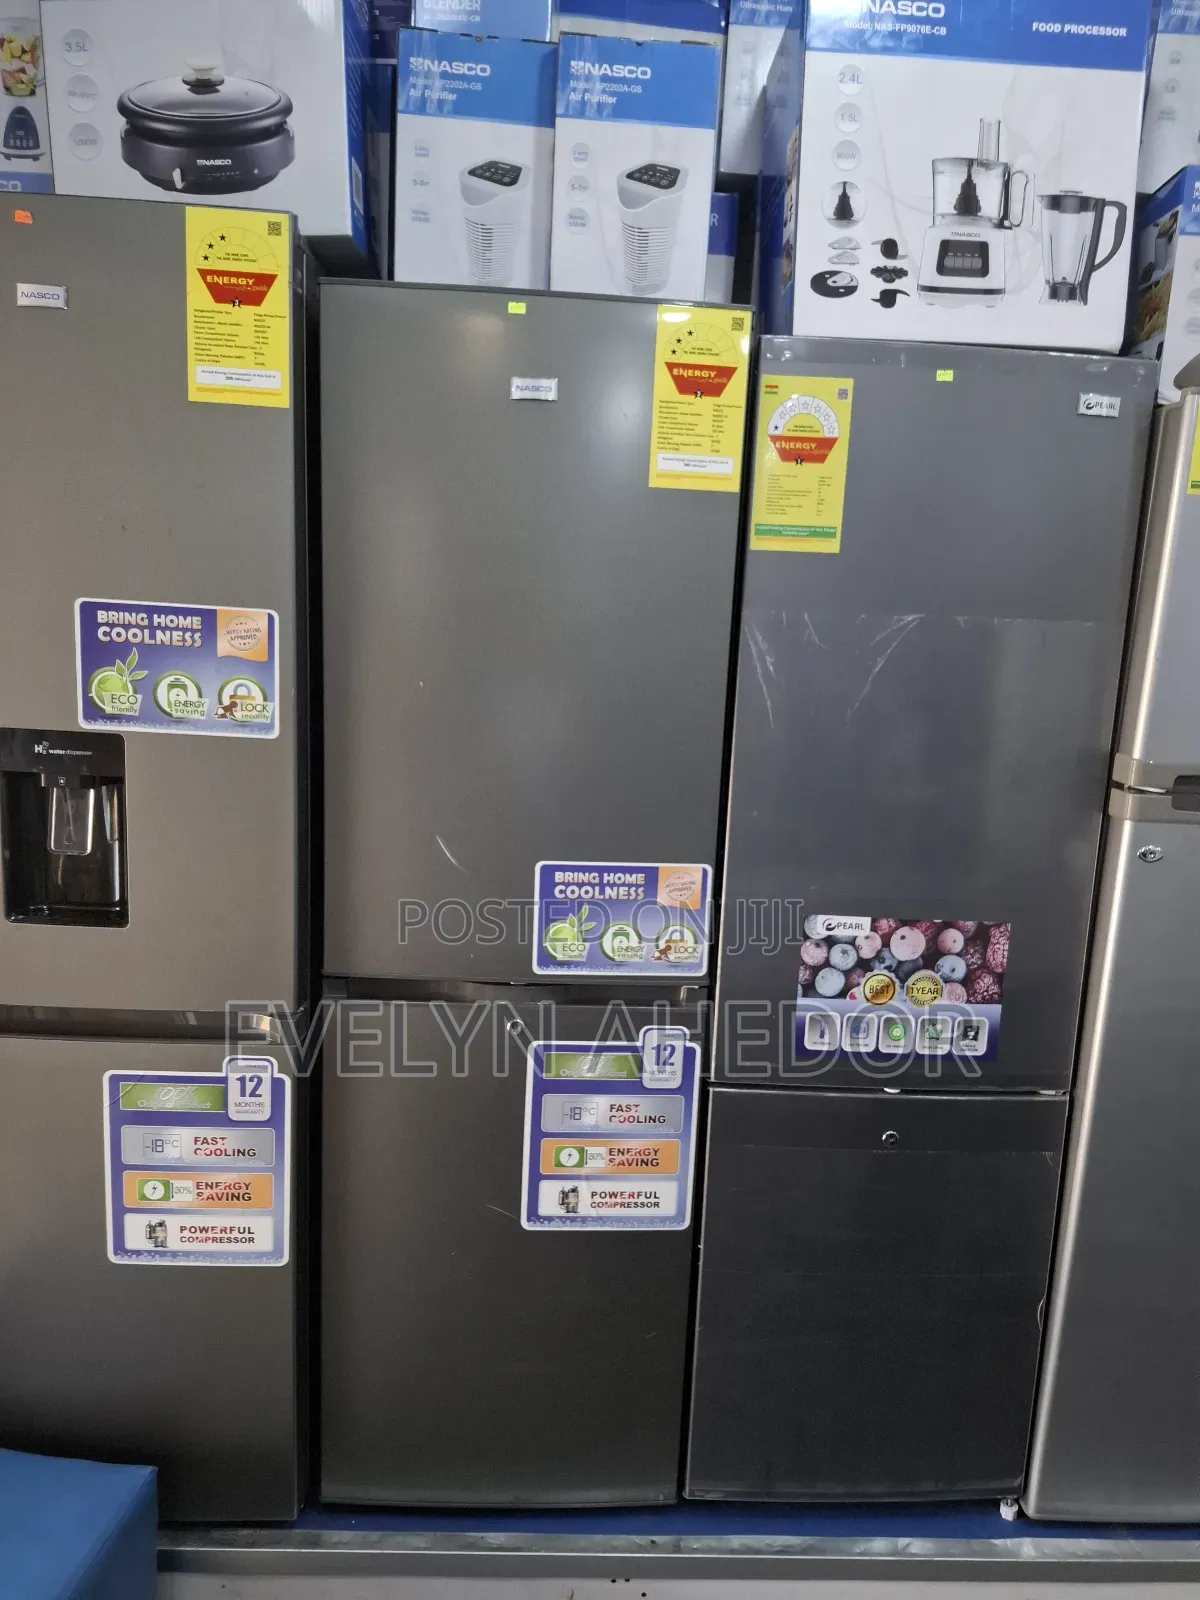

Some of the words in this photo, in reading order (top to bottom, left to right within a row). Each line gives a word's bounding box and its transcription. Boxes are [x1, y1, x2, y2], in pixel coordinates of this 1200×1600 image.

[862, 0, 946, 18] NASCO
[1031, 21, 1062, 33] FOOD
[1064, 23, 1127, 37] PROCESSOR
[423, 59, 491, 77] NASCO
[584, 61, 652, 79] NASCO
[839, 72, 863, 85] 2.4L
[409, 88, 423, 98] Air
[424, 90, 457, 101] Purifier
[569, 92, 583, 101] Air
[584, 92, 618, 104] Purifier
[206, 274, 255, 286] ENERGY
[21, 291, 60, 301] NASCO
[672, 367, 718, 379] ENERGY
[515, 385, 553, 393] NASCO
[775, 440, 818, 450] ENERGY
[97, 610, 149, 626] BRING
[153, 613, 202, 630] HOME
[97, 625, 203, 649] COOLNESS
[110, 693, 139, 705] ECO
[174, 699, 207, 709] ENERGY
[110, 704, 138, 715] friendly
[174, 707, 206, 717] saving
[240, 703, 270, 714] LOCK
[240, 713, 271, 722] security
[554, 871, 600, 884] BRING
[603, 873, 645, 885] HOME
[554, 885, 645, 900] COOLNESS
[836, 921, 866, 931] PEARL
[562, 942, 586, 953] ECO
[616, 945, 645, 954] ENERGY
[673, 945, 700, 955] LOCK
[869, 984, 890, 995] BEST
[916, 986, 940, 996] YEAR
[651, 1043, 677, 1067] 12
[235, 1074, 264, 1098] 12
[609, 1103, 641, 1113] FAST
[609, 1115, 667, 1124] COOLING
[193, 1136, 228, 1146] FAST
[193, 1147, 257, 1158] COOLING
[608, 1147, 661, 1157] ENERGY
[608, 1158, 660, 1167] SAVING
[174, 1185, 193, 1195] 30%
[195, 1181, 252, 1191] ENERGY
[195, 1191, 252, 1202] SAVING
[590, 1191, 661, 1200] POWERFUL
[590, 1200, 661, 1209] COMPRESSOR
[179, 1225, 256, 1235] POWERFUL
[179, 1236, 256, 1244] COMPRESSOR
